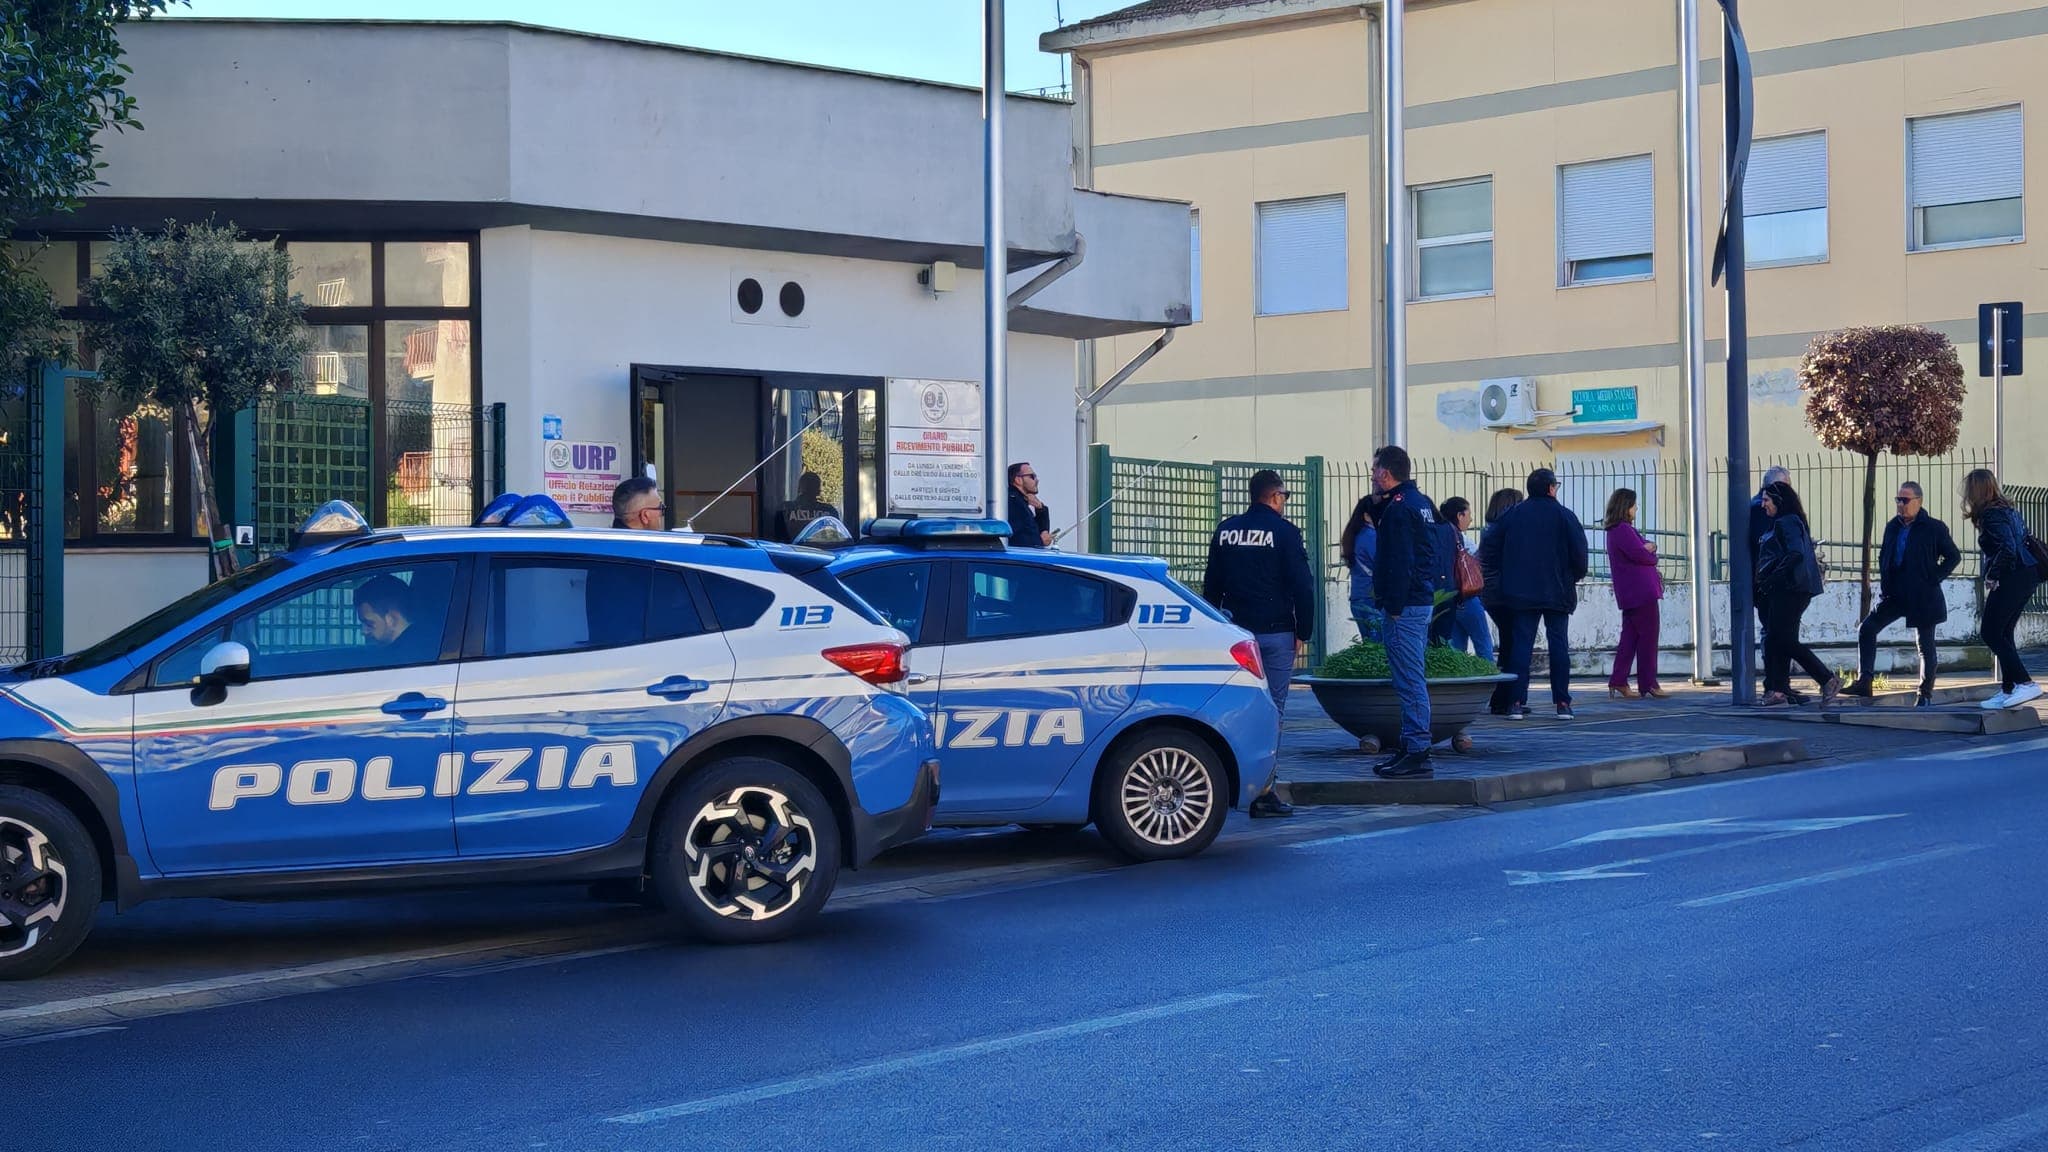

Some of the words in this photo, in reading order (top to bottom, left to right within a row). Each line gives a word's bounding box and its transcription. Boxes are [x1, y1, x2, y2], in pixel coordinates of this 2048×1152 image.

[923, 431, 948, 441] ORARIO
[896, 441, 940, 452] RICEVIMENTO
[941, 443, 975, 453] PUBBLICO
[572, 444, 617, 471] URP
[548, 480, 577, 490] Ufficio
[578, 481, 618, 491] Relazioni
[552, 493, 568, 501] con
[569, 492, 576, 502] il
[1219, 529, 1275, 548] POLIZIA
[779, 605, 834, 626] 113
[1138, 604, 1192, 624] 113
[929, 707, 1084, 749] IZIA
[208, 742, 638, 811] POLIZIA
